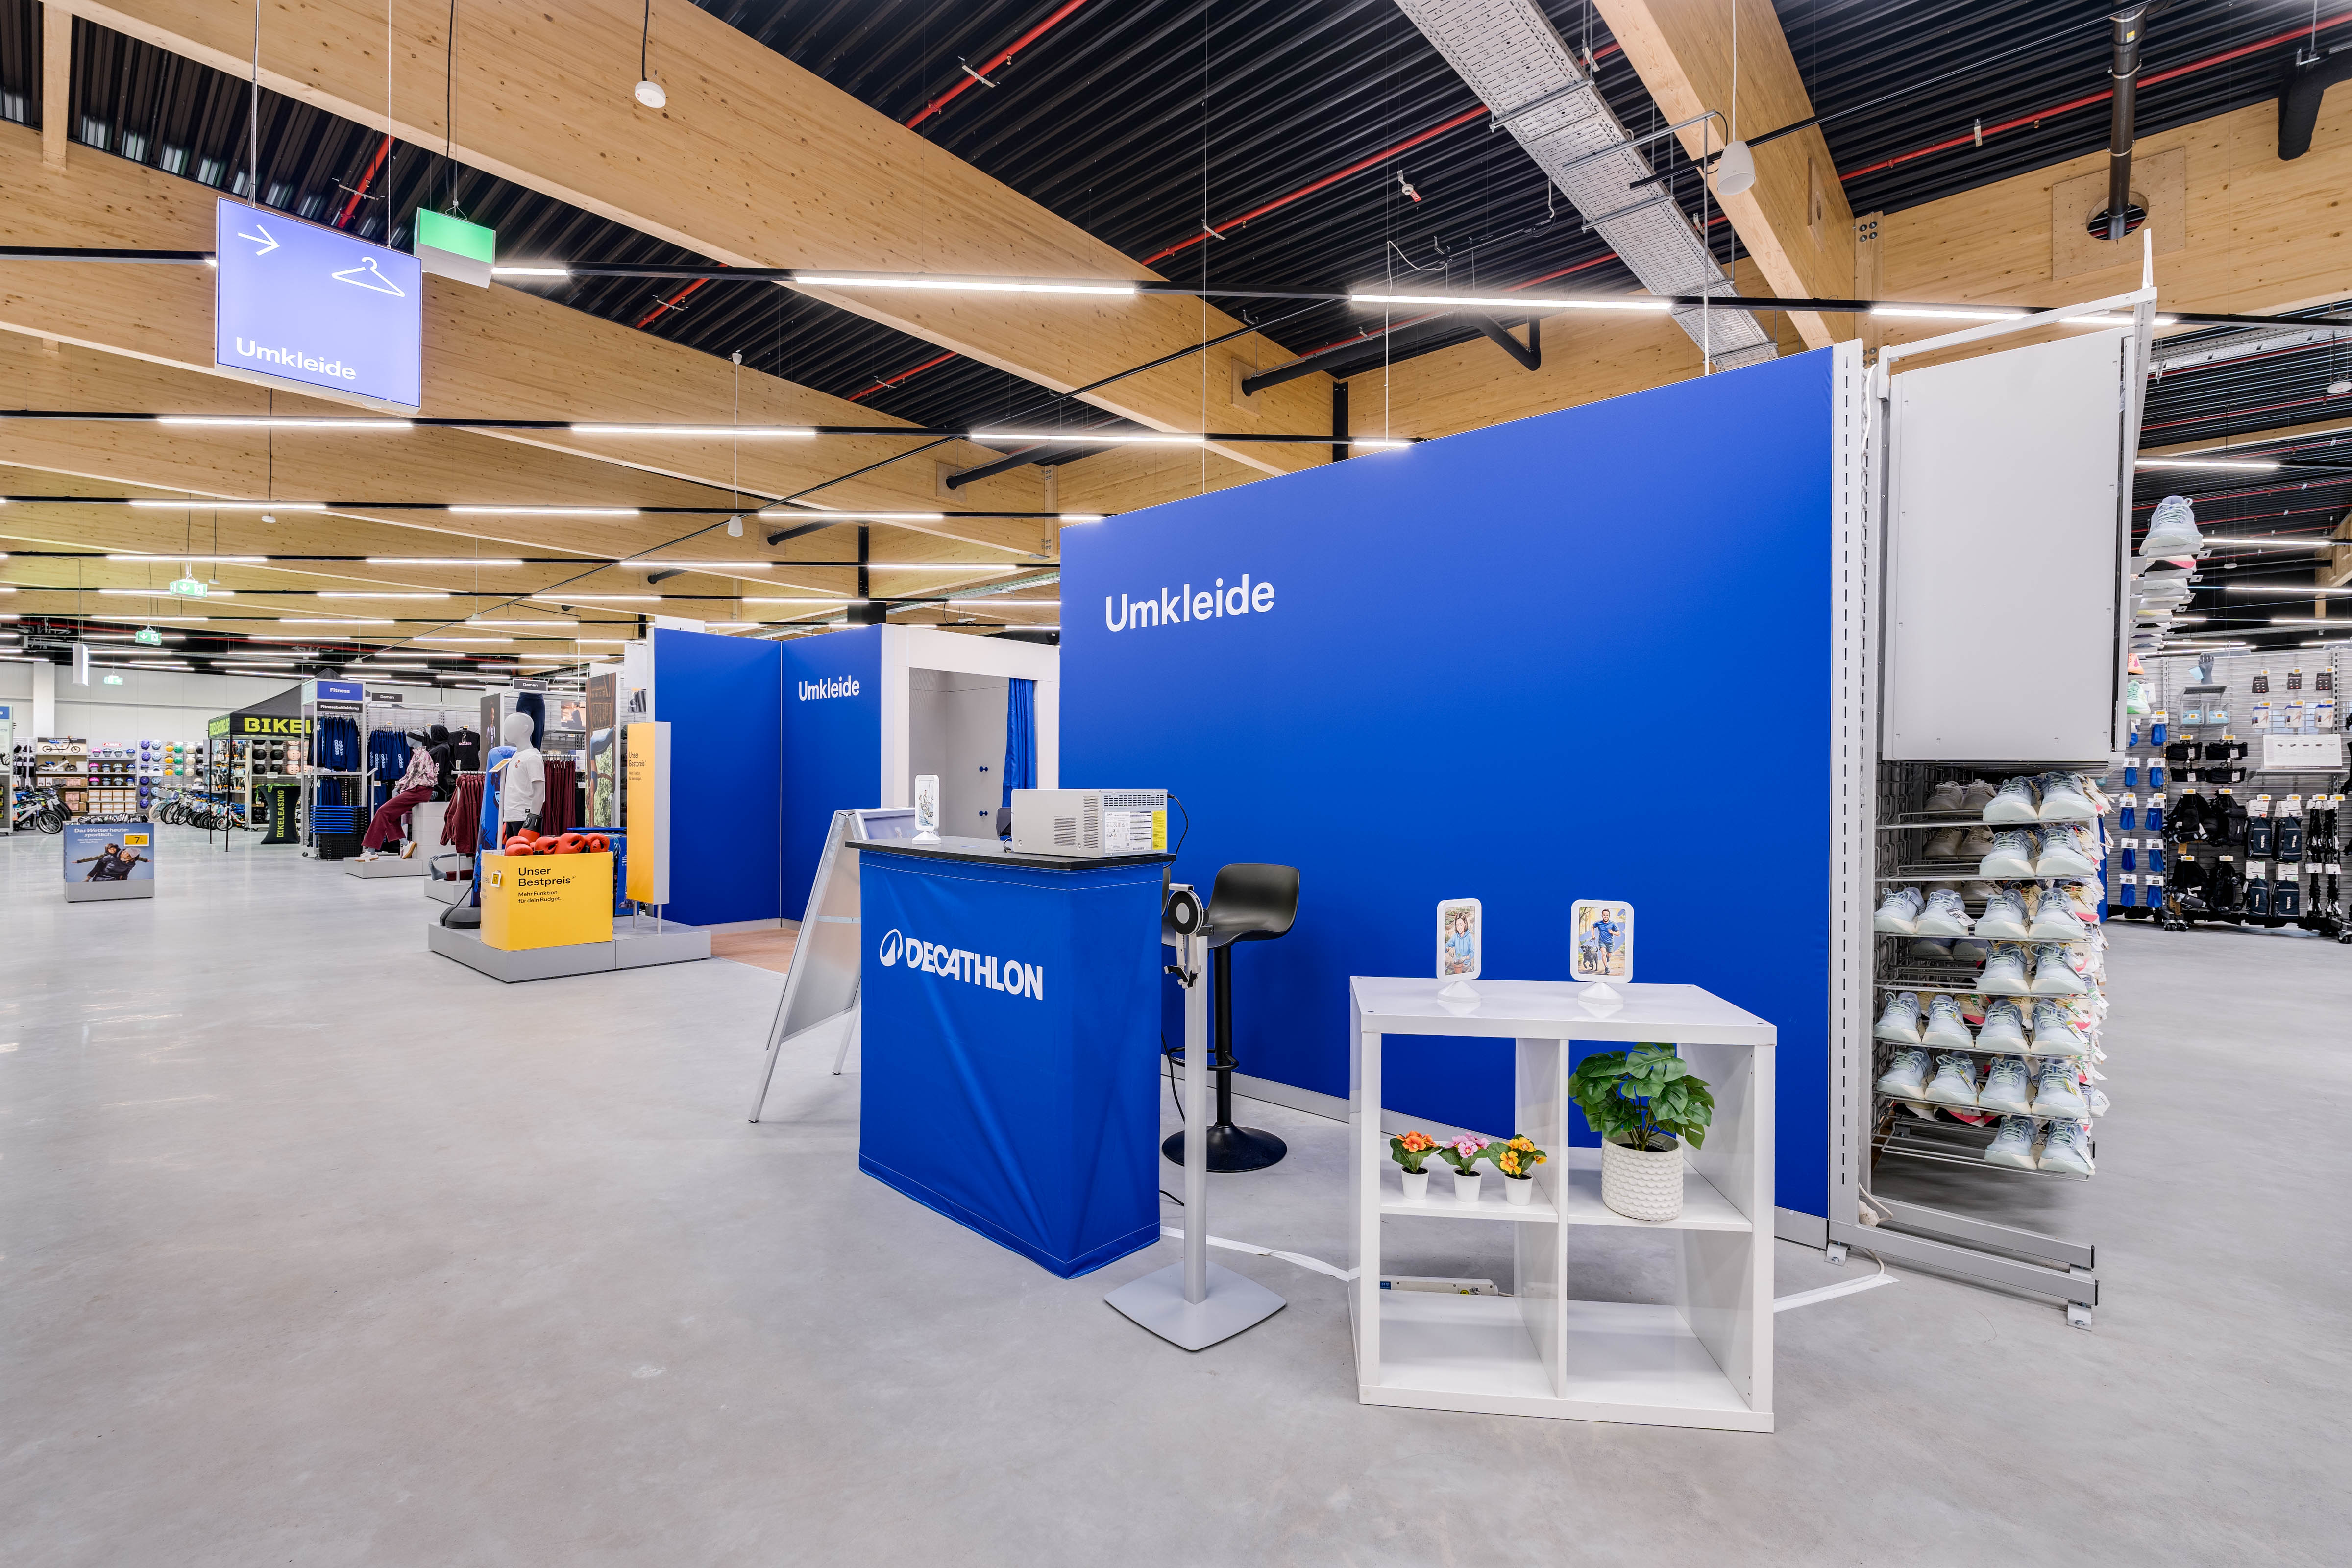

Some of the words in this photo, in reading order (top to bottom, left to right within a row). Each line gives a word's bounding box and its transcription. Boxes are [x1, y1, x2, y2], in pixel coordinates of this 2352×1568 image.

[236, 336, 356, 380] Umkleide
[1105, 573, 1275, 632] Umkleide
[798, 675, 860, 702] Umkleide
[629, 760, 645, 768] Bestpreis
[518, 867, 551, 876] Unser
[518, 876, 571, 887] Bestpreis
[906, 937, 1043, 1001] DECATHLON
